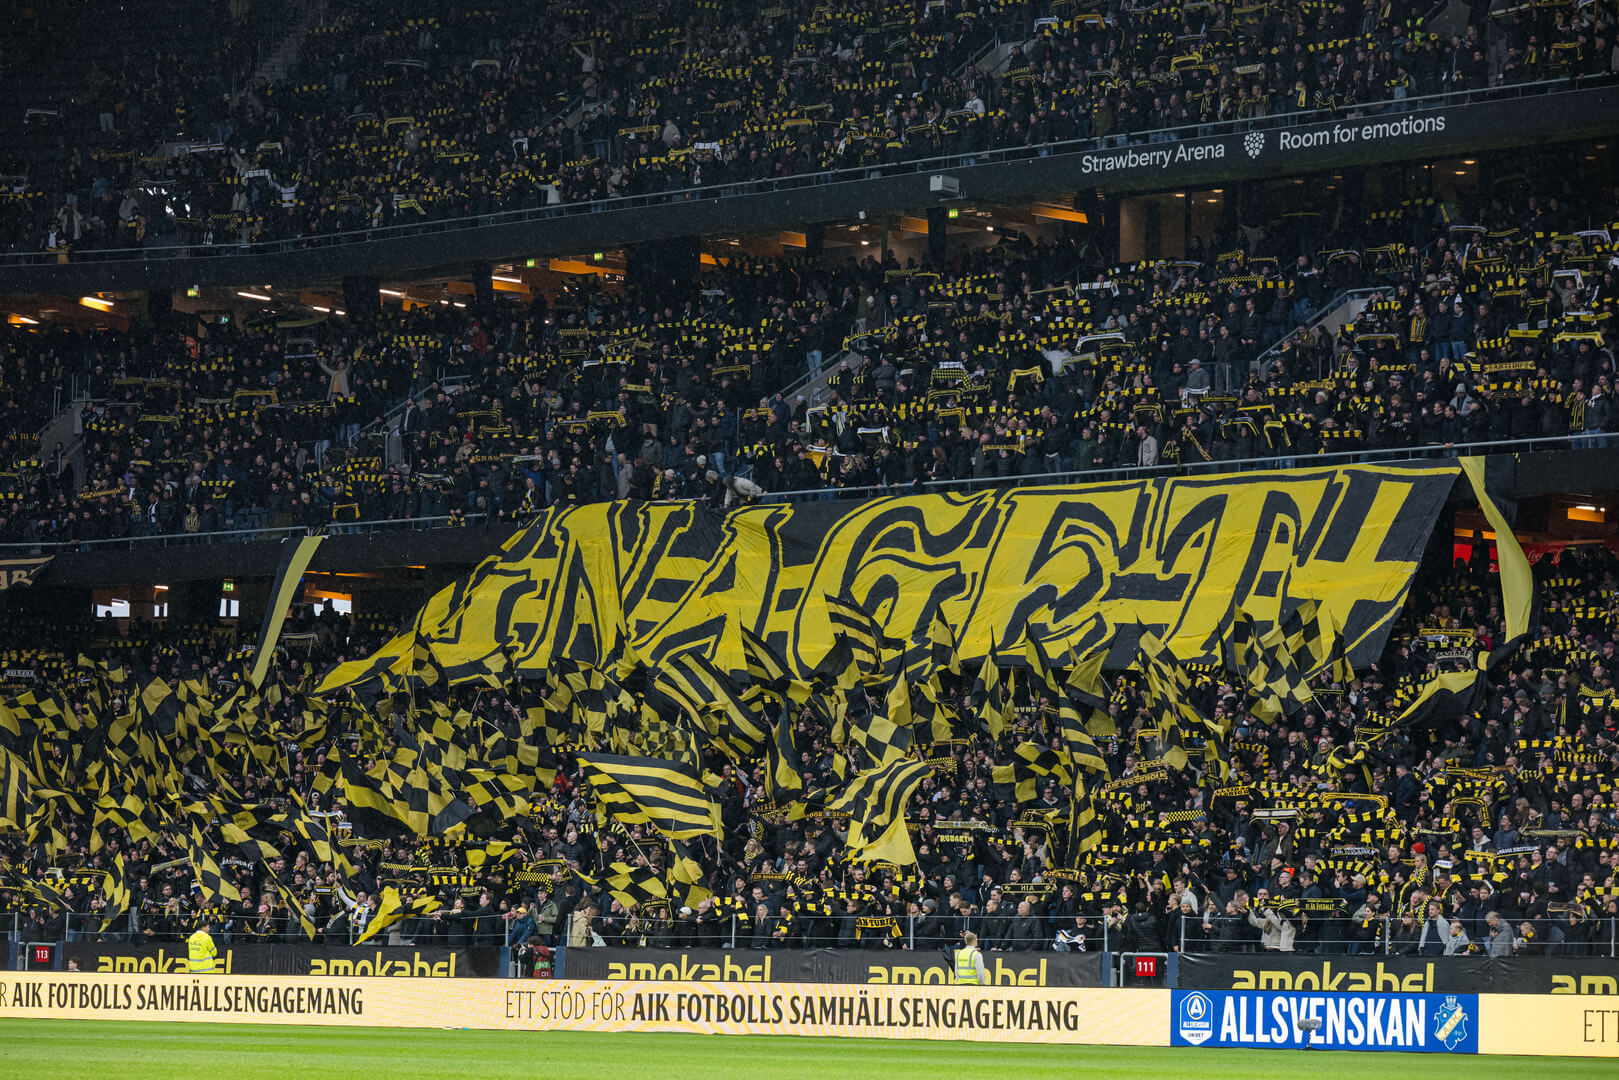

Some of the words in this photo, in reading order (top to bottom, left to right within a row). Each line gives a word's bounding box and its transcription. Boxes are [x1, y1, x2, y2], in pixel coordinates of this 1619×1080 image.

[1280, 130, 1330, 151] Room
[1333, 124, 1358, 144] for
[1362, 115, 1445, 141] emotions
[1081, 149, 1171, 174] Strawberry
[1175, 143, 1225, 162] Arena
[1378, 364, 1409, 372] AIK
[36, 950, 49, 959] 113
[97, 949, 233, 973] amokael
[309, 951, 457, 977] amokabel
[608, 954, 772, 982] amokabel
[1137, 961, 1154, 973] 111
[867, 958, 1047, 987] amobel
[1232, 962, 1435, 992] amokabel
[12, 983, 43, 1008] AIK
[48, 983, 132, 1010] FOTBOLLS
[137, 980, 363, 1015] SAMHÄLLSENGAGEMANG
[506, 990, 535, 1020] ETT
[541, 986, 586, 1021] STÖD
[592, 986, 625, 1021] FÖR
[631, 993, 671, 1022] AIK
[677, 993, 783, 1025] FOTBOLLS
[789, 990, 1079, 1031] SAMHÄLLSENGAGEMANG
[1220, 996, 1426, 1047] ALLSVENSKAN
